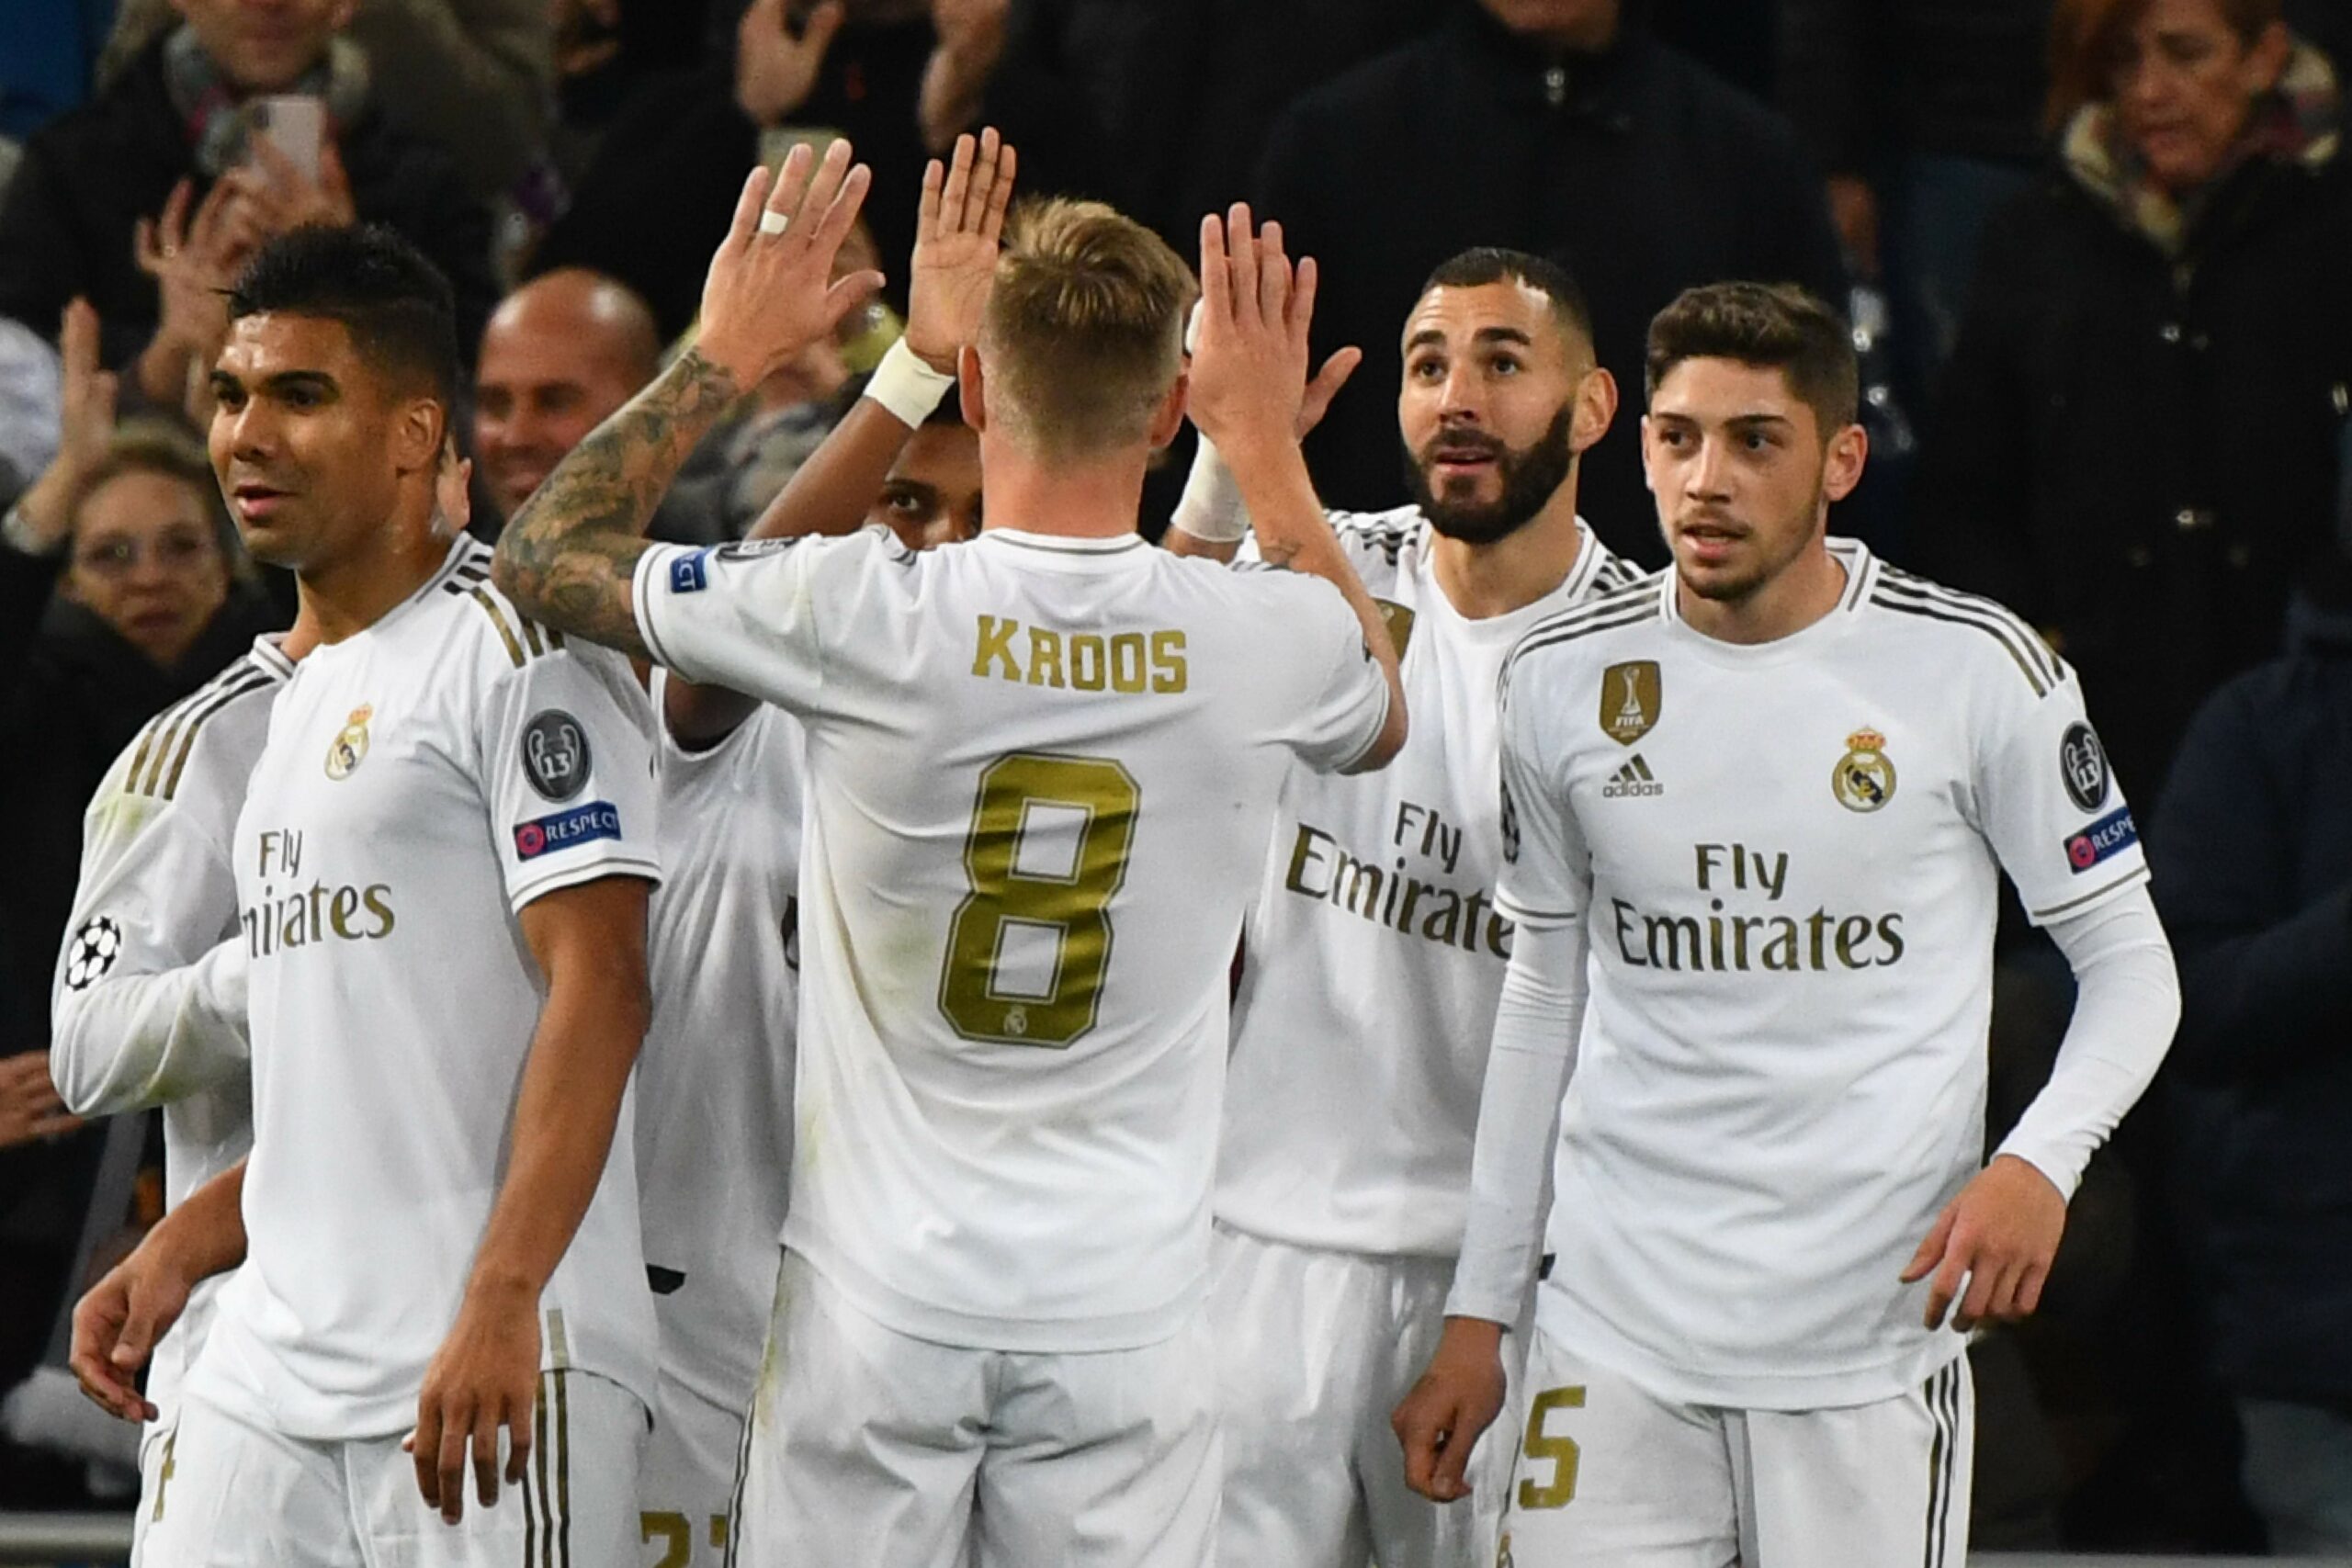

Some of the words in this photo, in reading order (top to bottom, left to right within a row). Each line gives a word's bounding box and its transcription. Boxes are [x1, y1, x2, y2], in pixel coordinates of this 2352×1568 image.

[971, 615, 1187, 694] KROOS
[1615, 715, 1645, 728] FIFA
[544, 752, 571, 779] 13
[1602, 783, 1664, 798] adidas
[259, 828, 302, 878] Fly
[1394, 800, 1462, 874] Fly
[1695, 843, 1789, 901] Fly
[242, 877, 395, 959] mirates
[937, 750, 1142, 1050] 8
[1285, 822, 1515, 960] Emirate
[1611, 897, 1905, 972] Emirates
